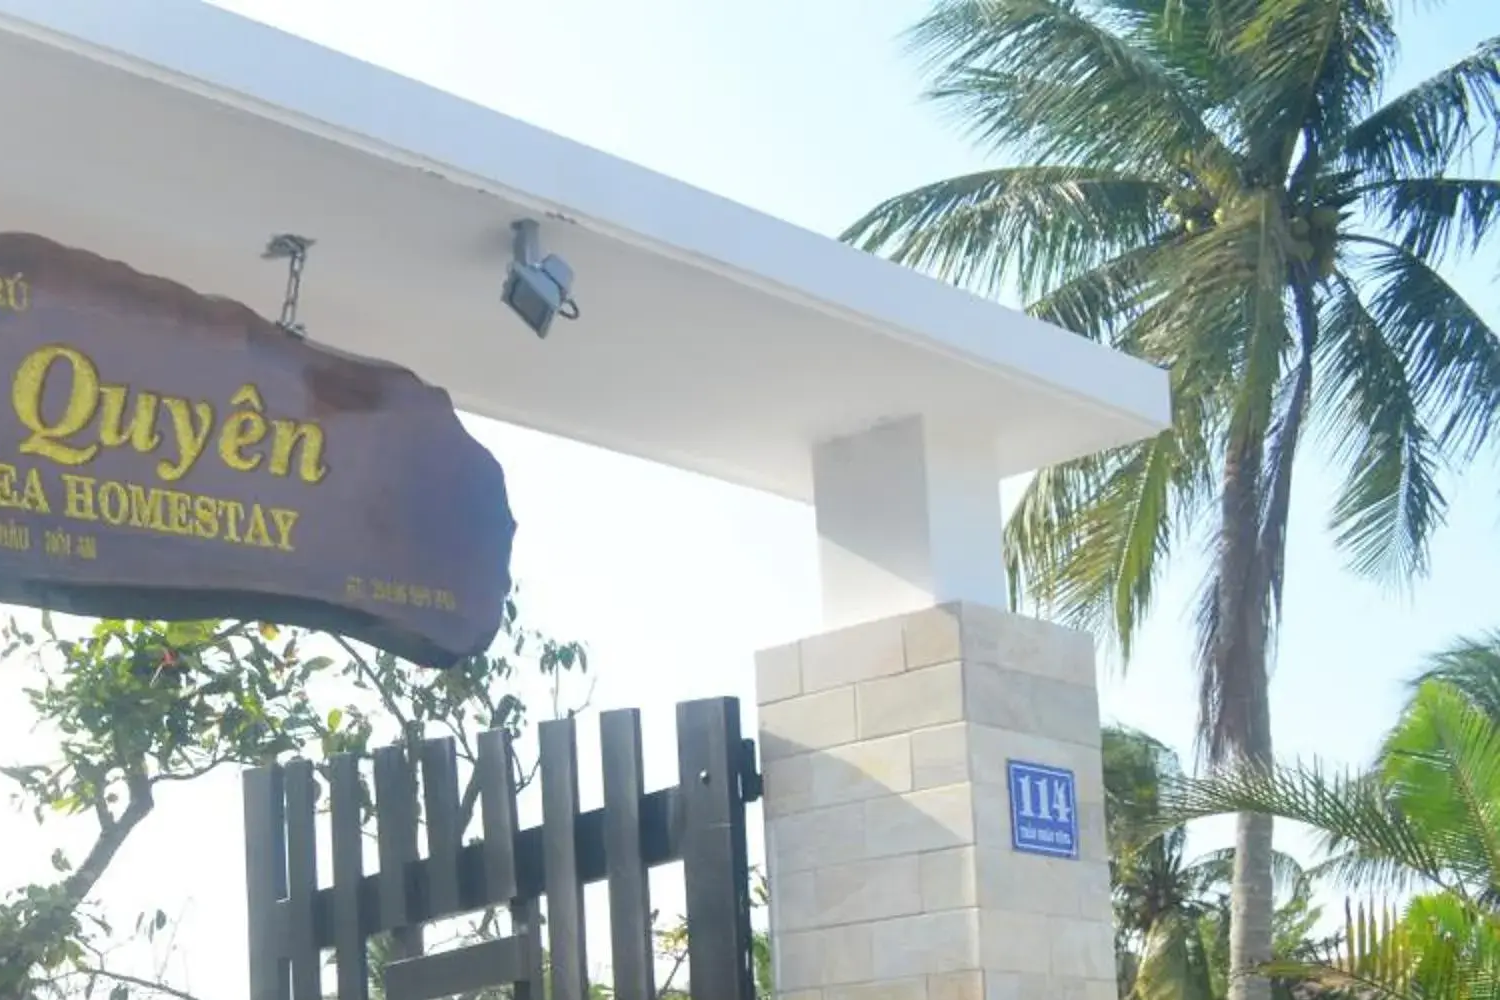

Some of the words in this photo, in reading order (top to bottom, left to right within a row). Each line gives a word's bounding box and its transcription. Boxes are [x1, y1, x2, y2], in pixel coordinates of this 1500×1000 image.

[11, 345, 328, 484] Quyên
[60, 474, 300, 552] HOMESTAY
[1019, 775, 1071, 823] 114
